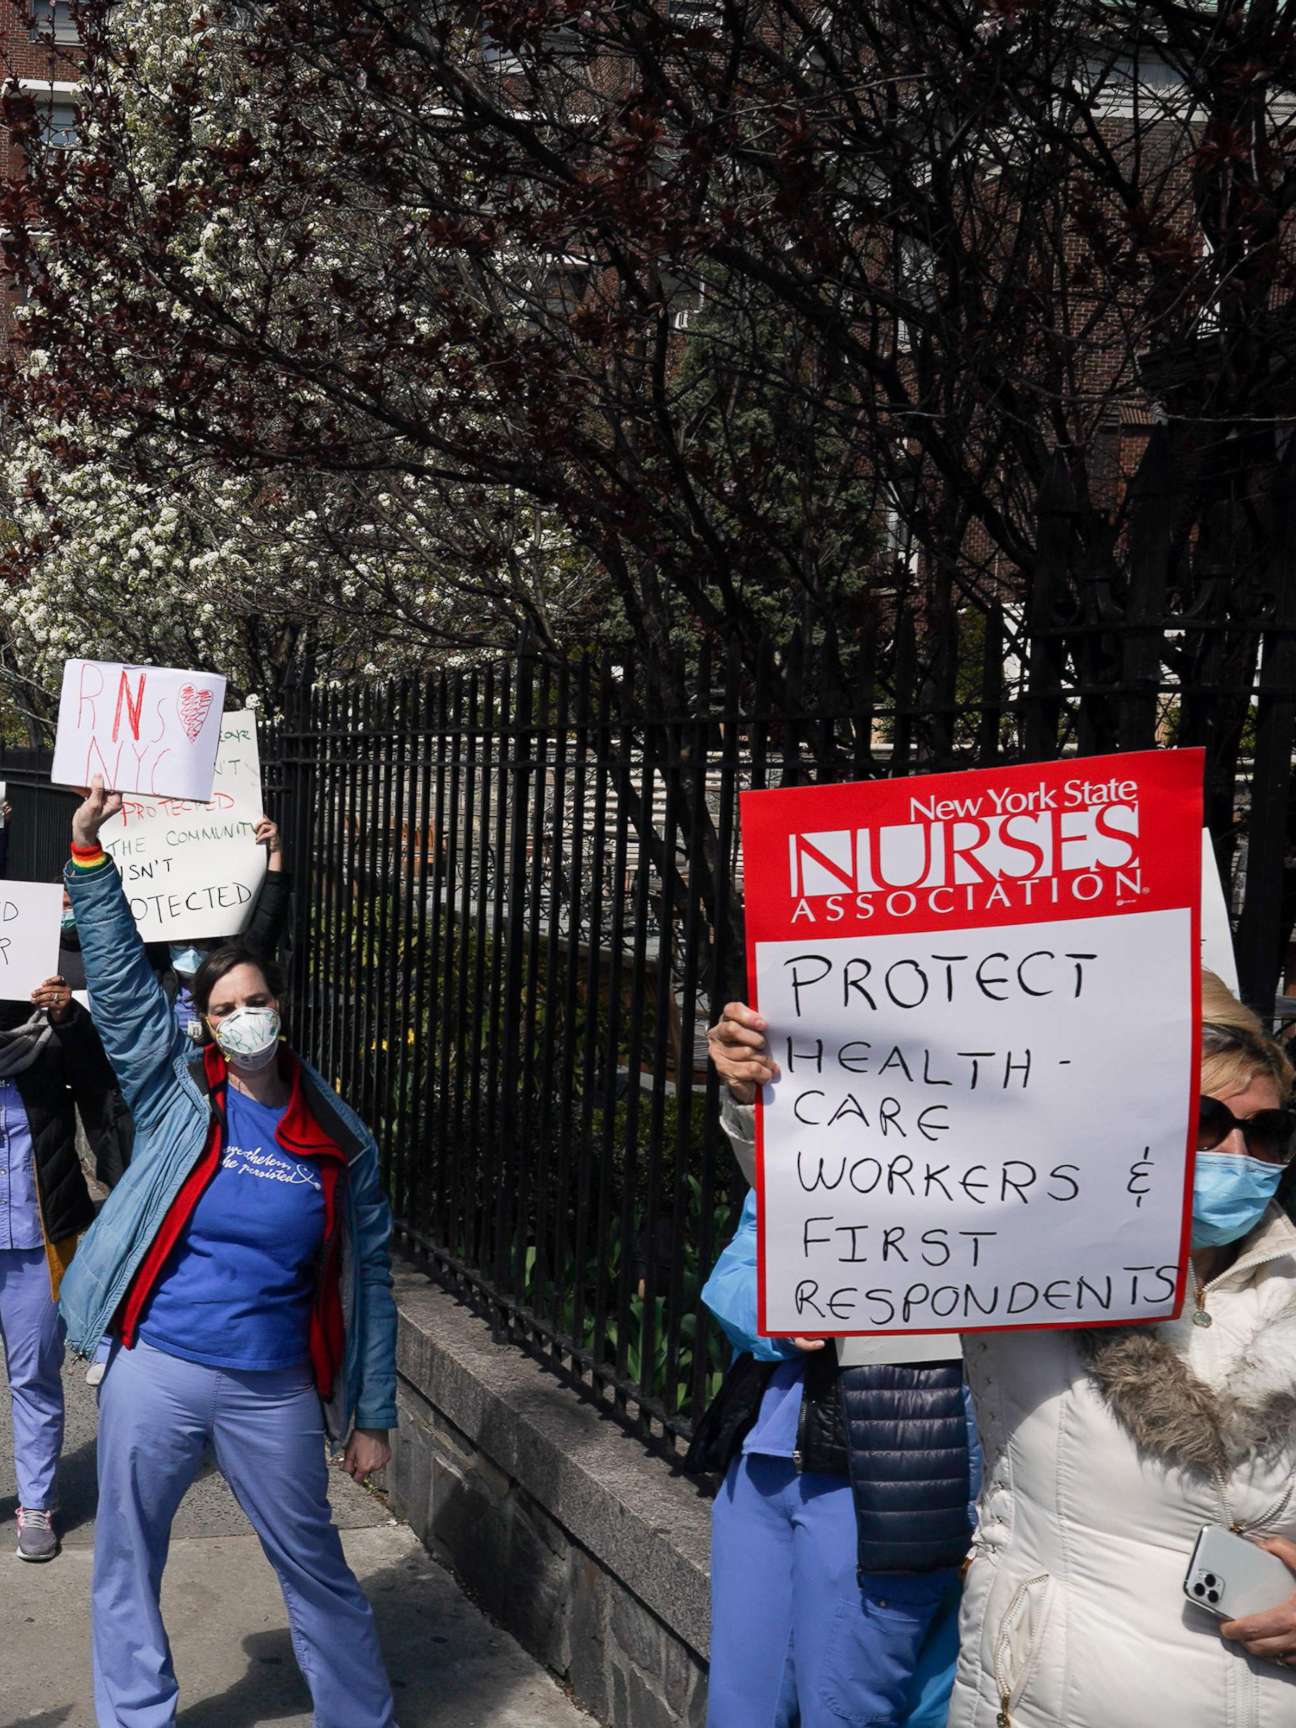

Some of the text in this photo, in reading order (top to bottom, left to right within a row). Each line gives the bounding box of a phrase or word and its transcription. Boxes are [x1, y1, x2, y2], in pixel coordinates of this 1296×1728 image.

[84, 736, 172, 796] NYC
[909, 777, 1139, 826] New York State
[105, 837, 145, 857] THE
[788, 799, 1141, 898] NURSES
[130, 881, 252, 924] OTECTED
[791, 867, 1144, 924] ASSOCIATION
[783, 951, 1098, 1018] PROTECT
[793, 1090, 951, 1141] CARE
[797, 1145, 1154, 1208] WORKERS &
[804, 1216, 998, 1267] FIRST
[795, 1265, 1182, 1327] RESPONDENTS
